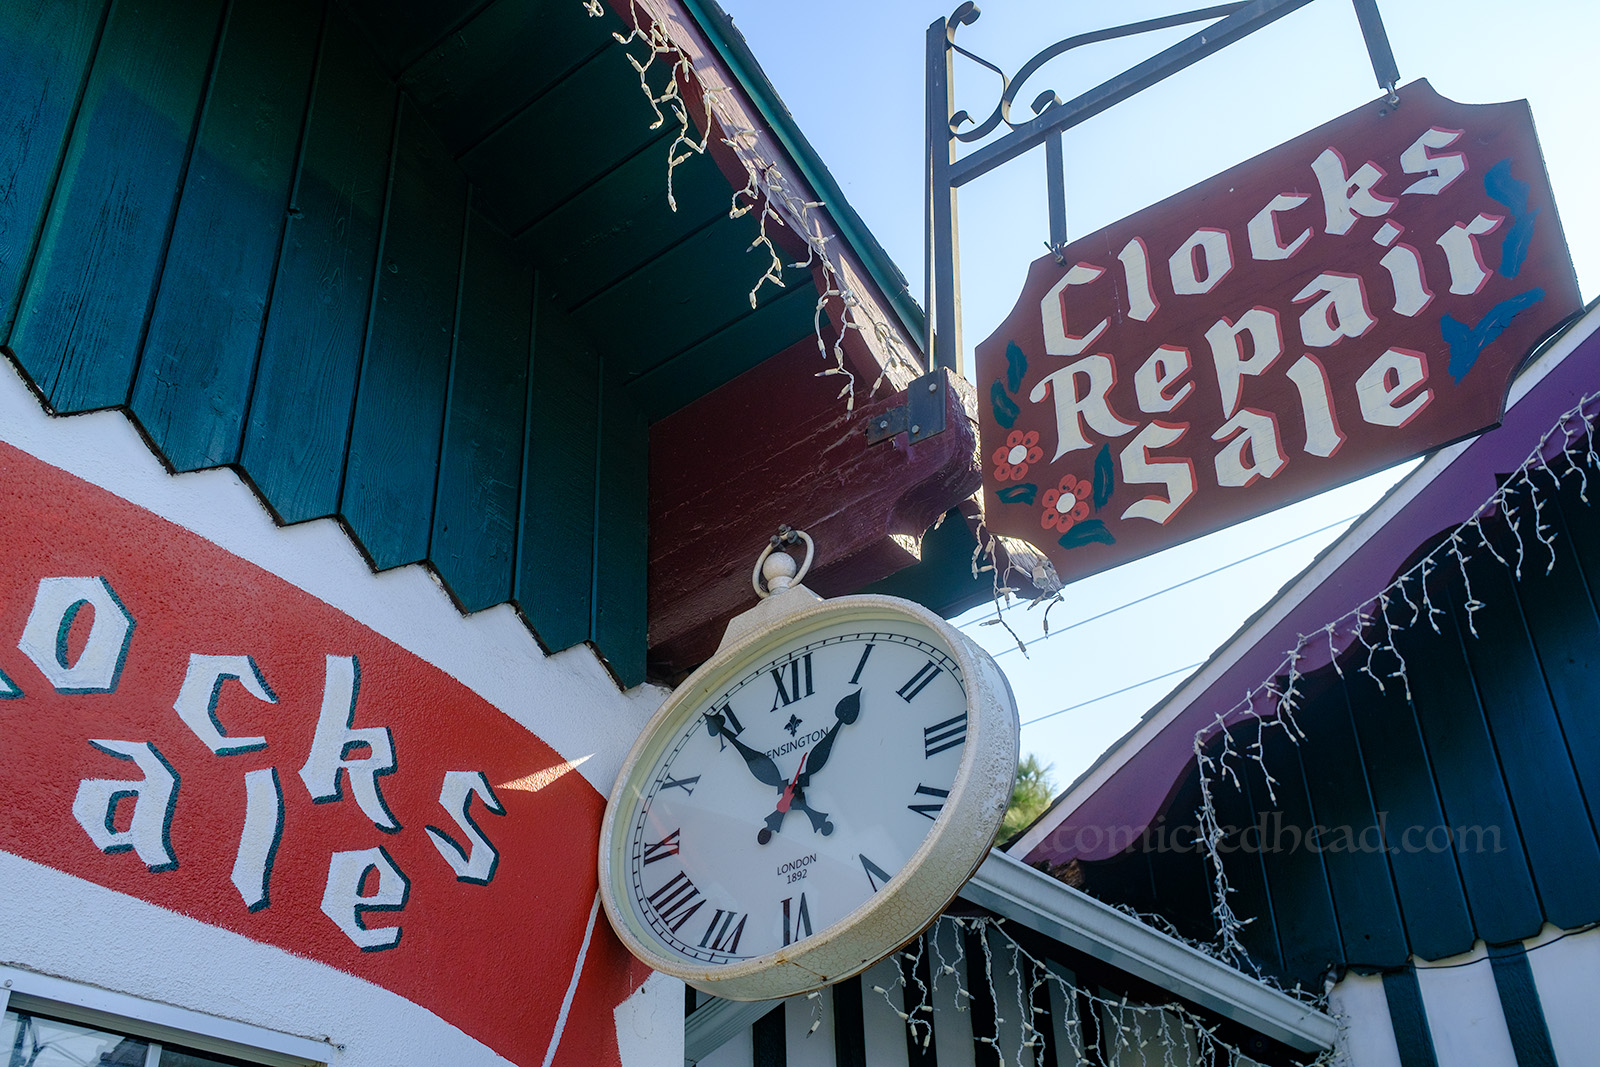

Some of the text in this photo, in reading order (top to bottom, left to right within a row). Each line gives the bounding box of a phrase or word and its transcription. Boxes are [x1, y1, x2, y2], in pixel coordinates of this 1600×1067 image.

[1040, 126, 1469, 356] Clocks
[1029, 212, 1505, 465] Repair
[1120, 346, 1434, 525] Sale
[0, 574, 507, 886] ocks
[769, 652, 815, 712] XII
[763, 726, 829, 759] ENSINGTON
[777, 853, 817, 876] LONDON
[786, 868, 808, 885] 1892
